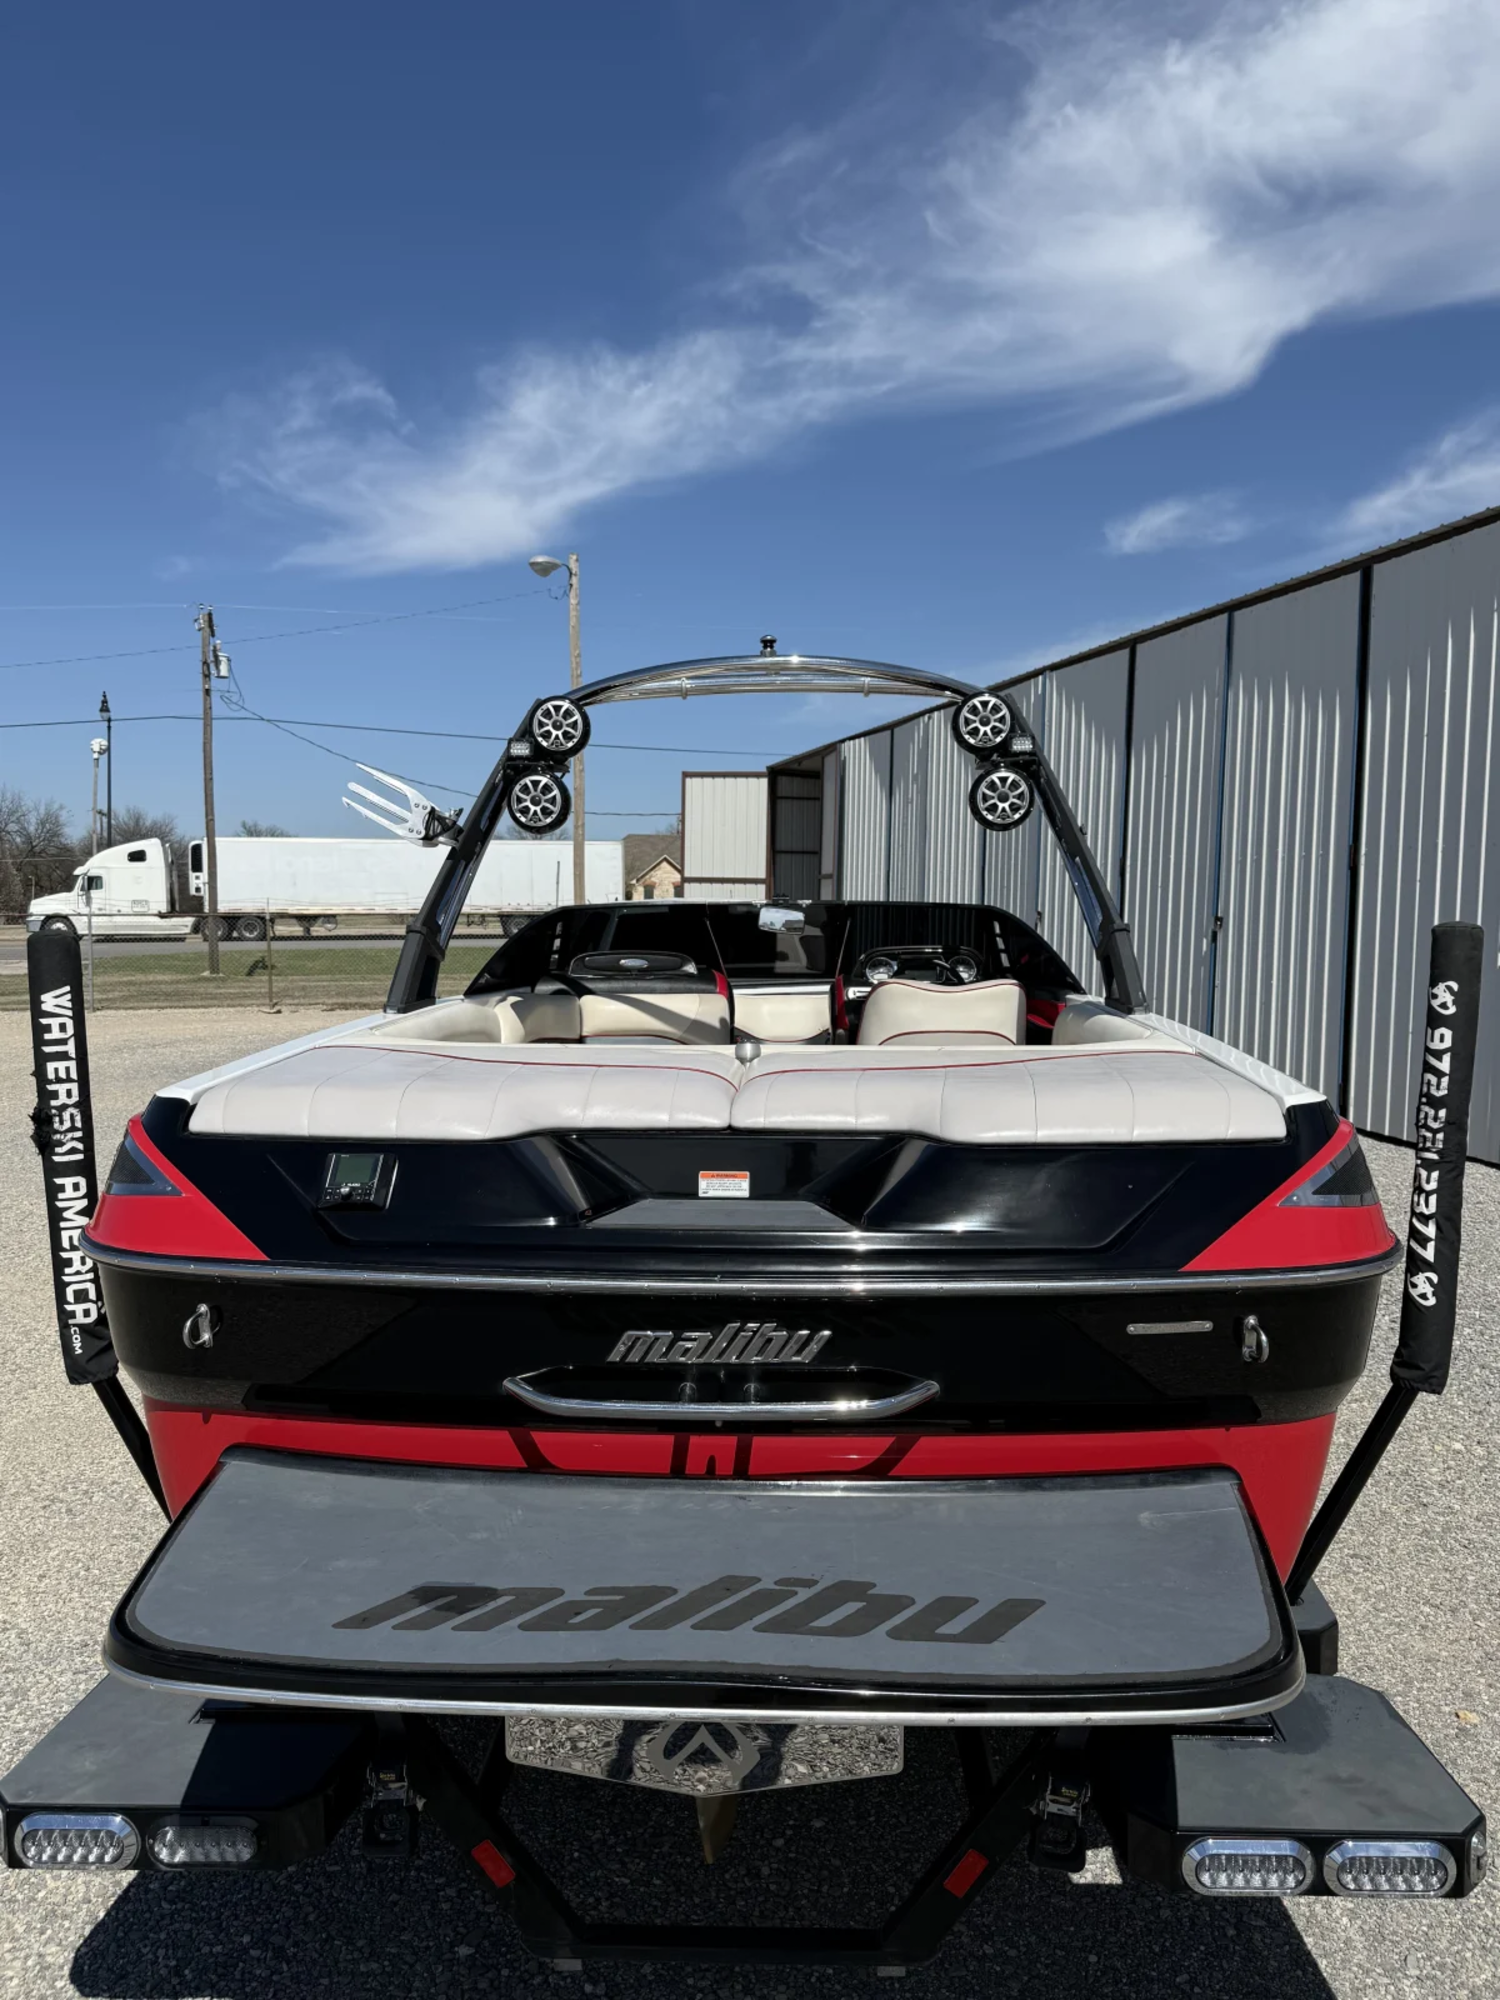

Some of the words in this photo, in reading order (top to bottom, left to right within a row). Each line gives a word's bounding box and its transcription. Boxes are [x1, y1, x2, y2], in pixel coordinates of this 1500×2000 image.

[38, 985, 85, 1161] WATERSKI
[605, 1322, 833, 1364] malibu
[331, 1575, 1047, 1644] malibu
